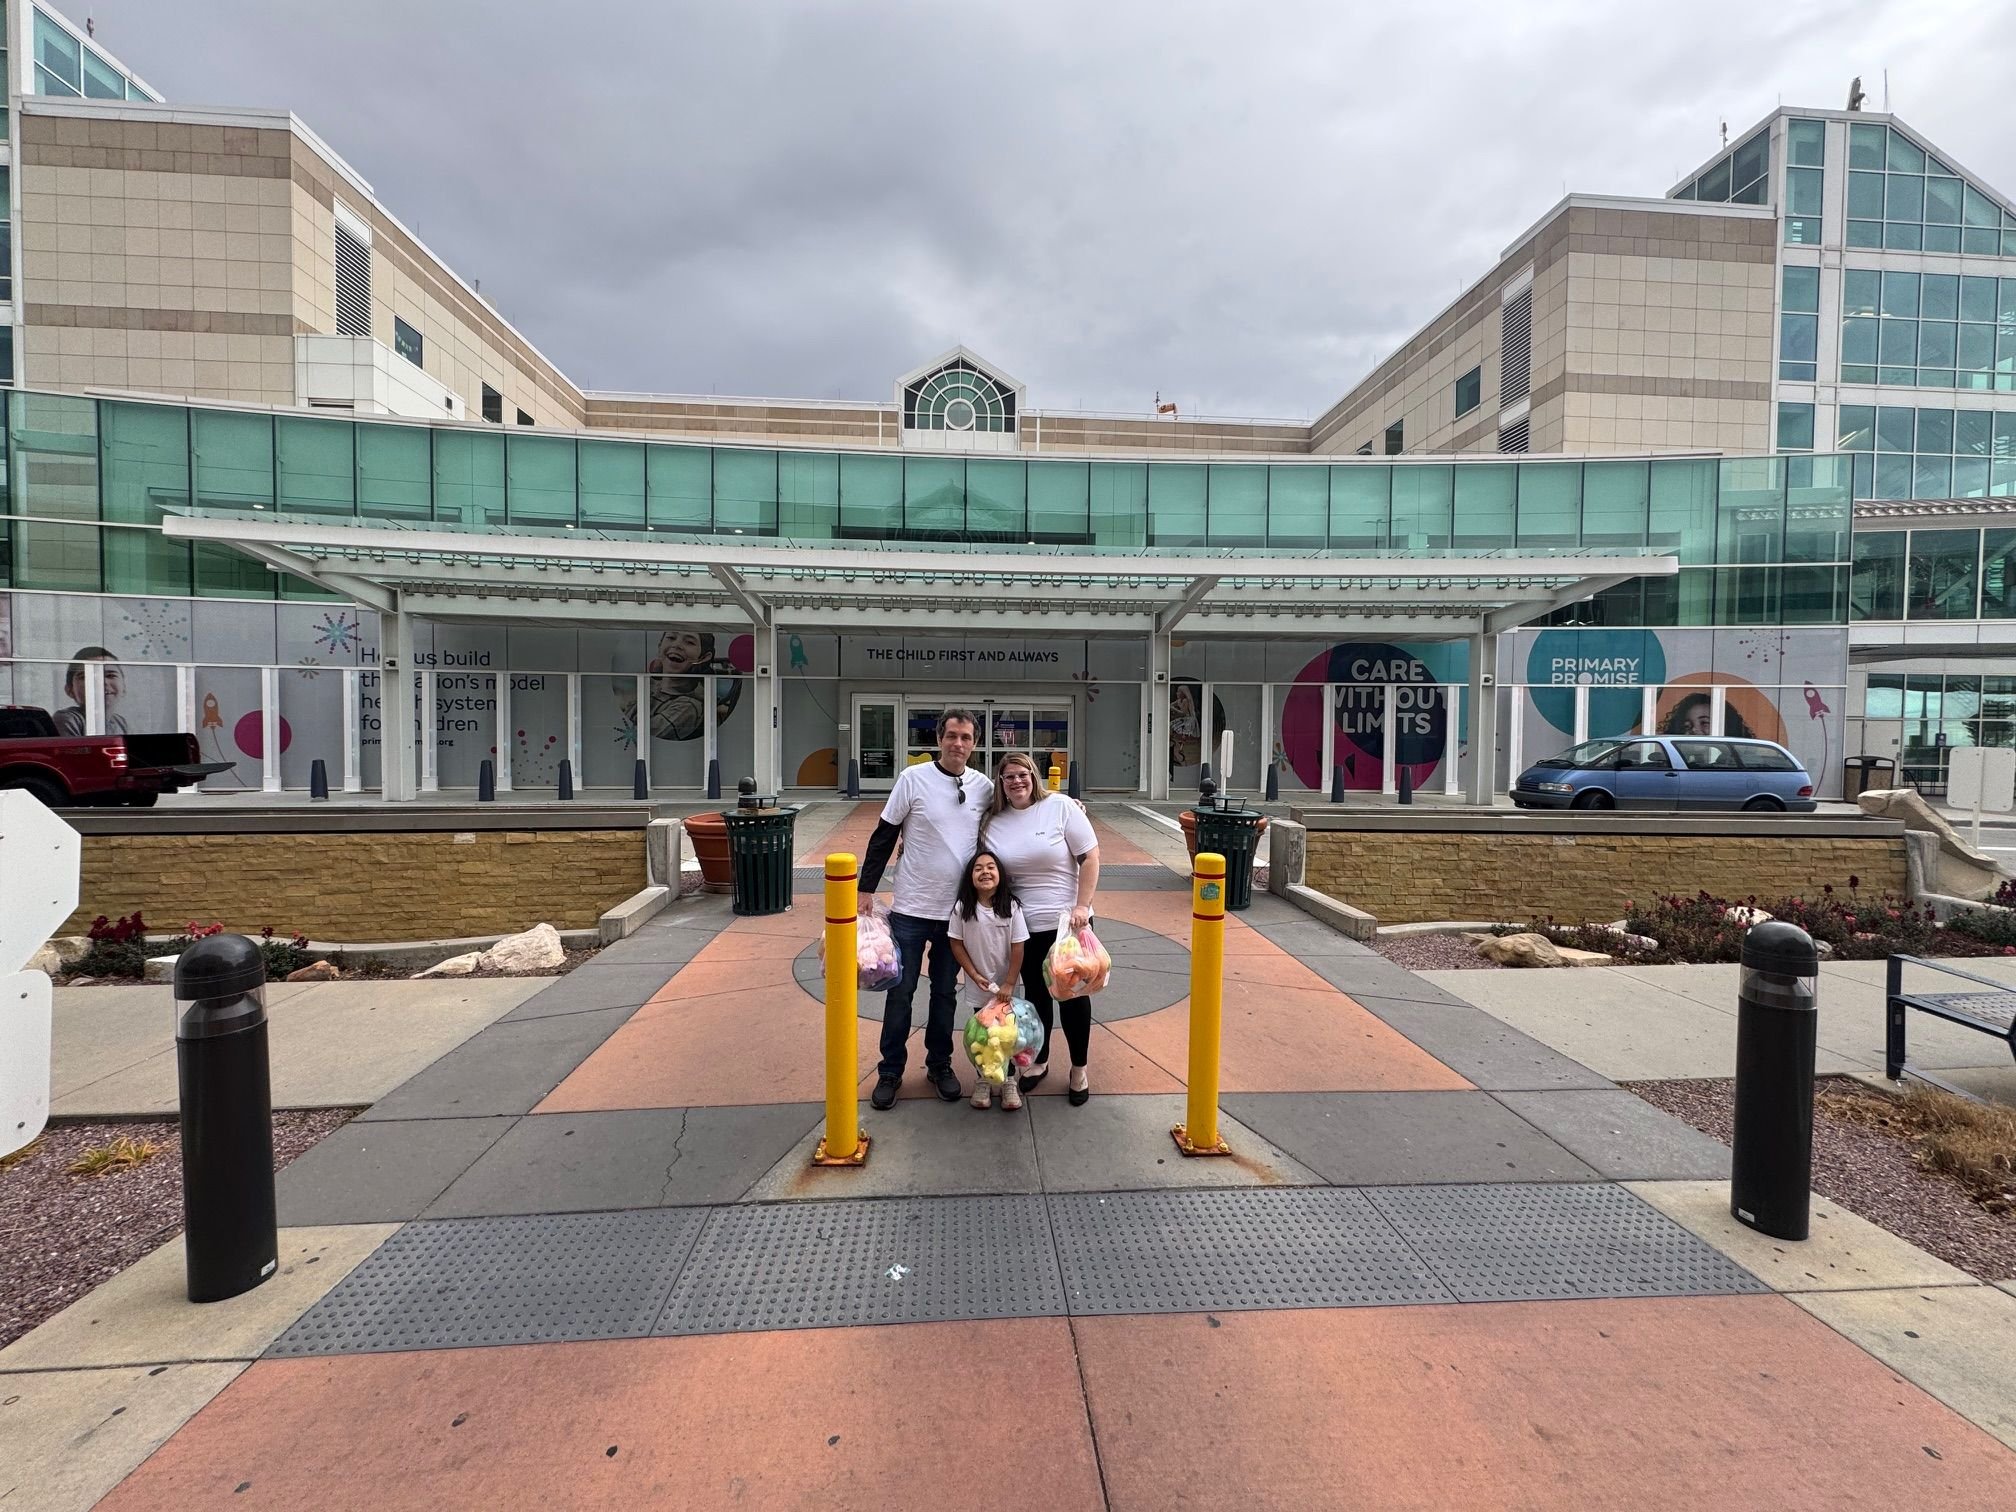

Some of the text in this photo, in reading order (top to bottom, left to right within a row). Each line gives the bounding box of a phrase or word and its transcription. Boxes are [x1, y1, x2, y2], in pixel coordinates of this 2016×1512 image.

[414, 650, 491, 666] us build
[867, 648, 1059, 663] THE CHILD FIRST AND ALWAYS
[1351, 659, 1425, 681] CARE
[1551, 657, 1640, 672] PRIMARY
[360, 671, 381, 687] th
[1551, 672, 1639, 688] PROMISE
[361, 713, 381, 730] fo
[1342, 711, 1432, 735] LIMTS
